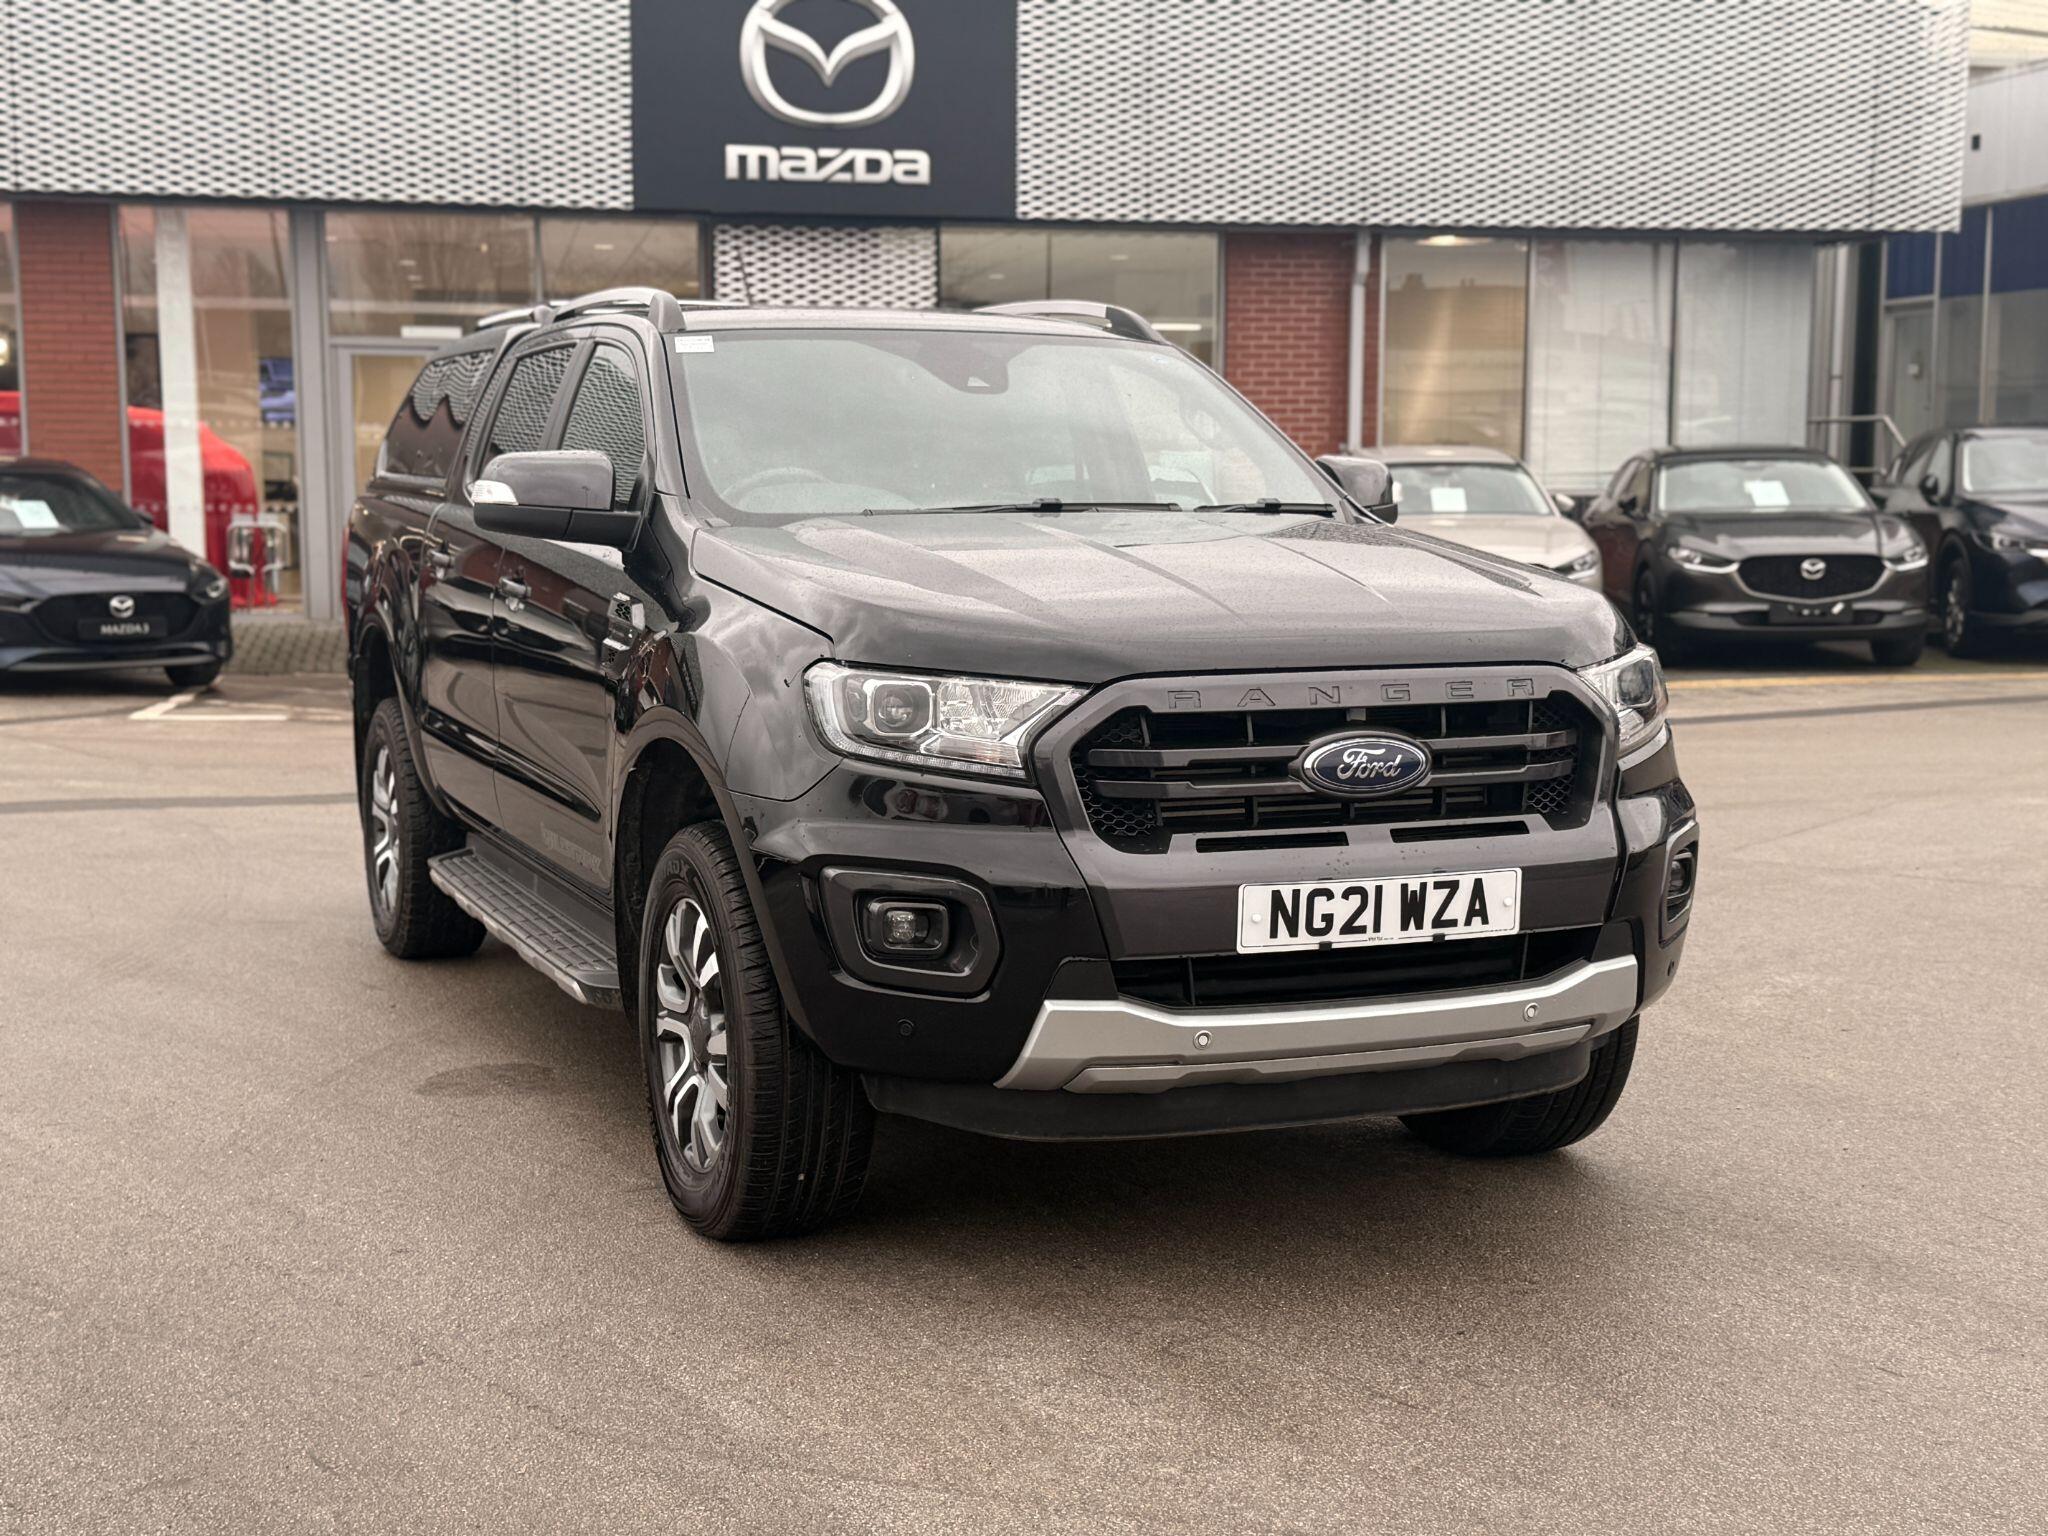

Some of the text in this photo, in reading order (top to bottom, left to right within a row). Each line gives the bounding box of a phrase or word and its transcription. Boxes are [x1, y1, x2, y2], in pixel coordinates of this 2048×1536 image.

[1168, 678, 1534, 709] RANGER
[1337, 748, 1402, 780] Ford
[1269, 878, 1489, 939] NG21 WZA
